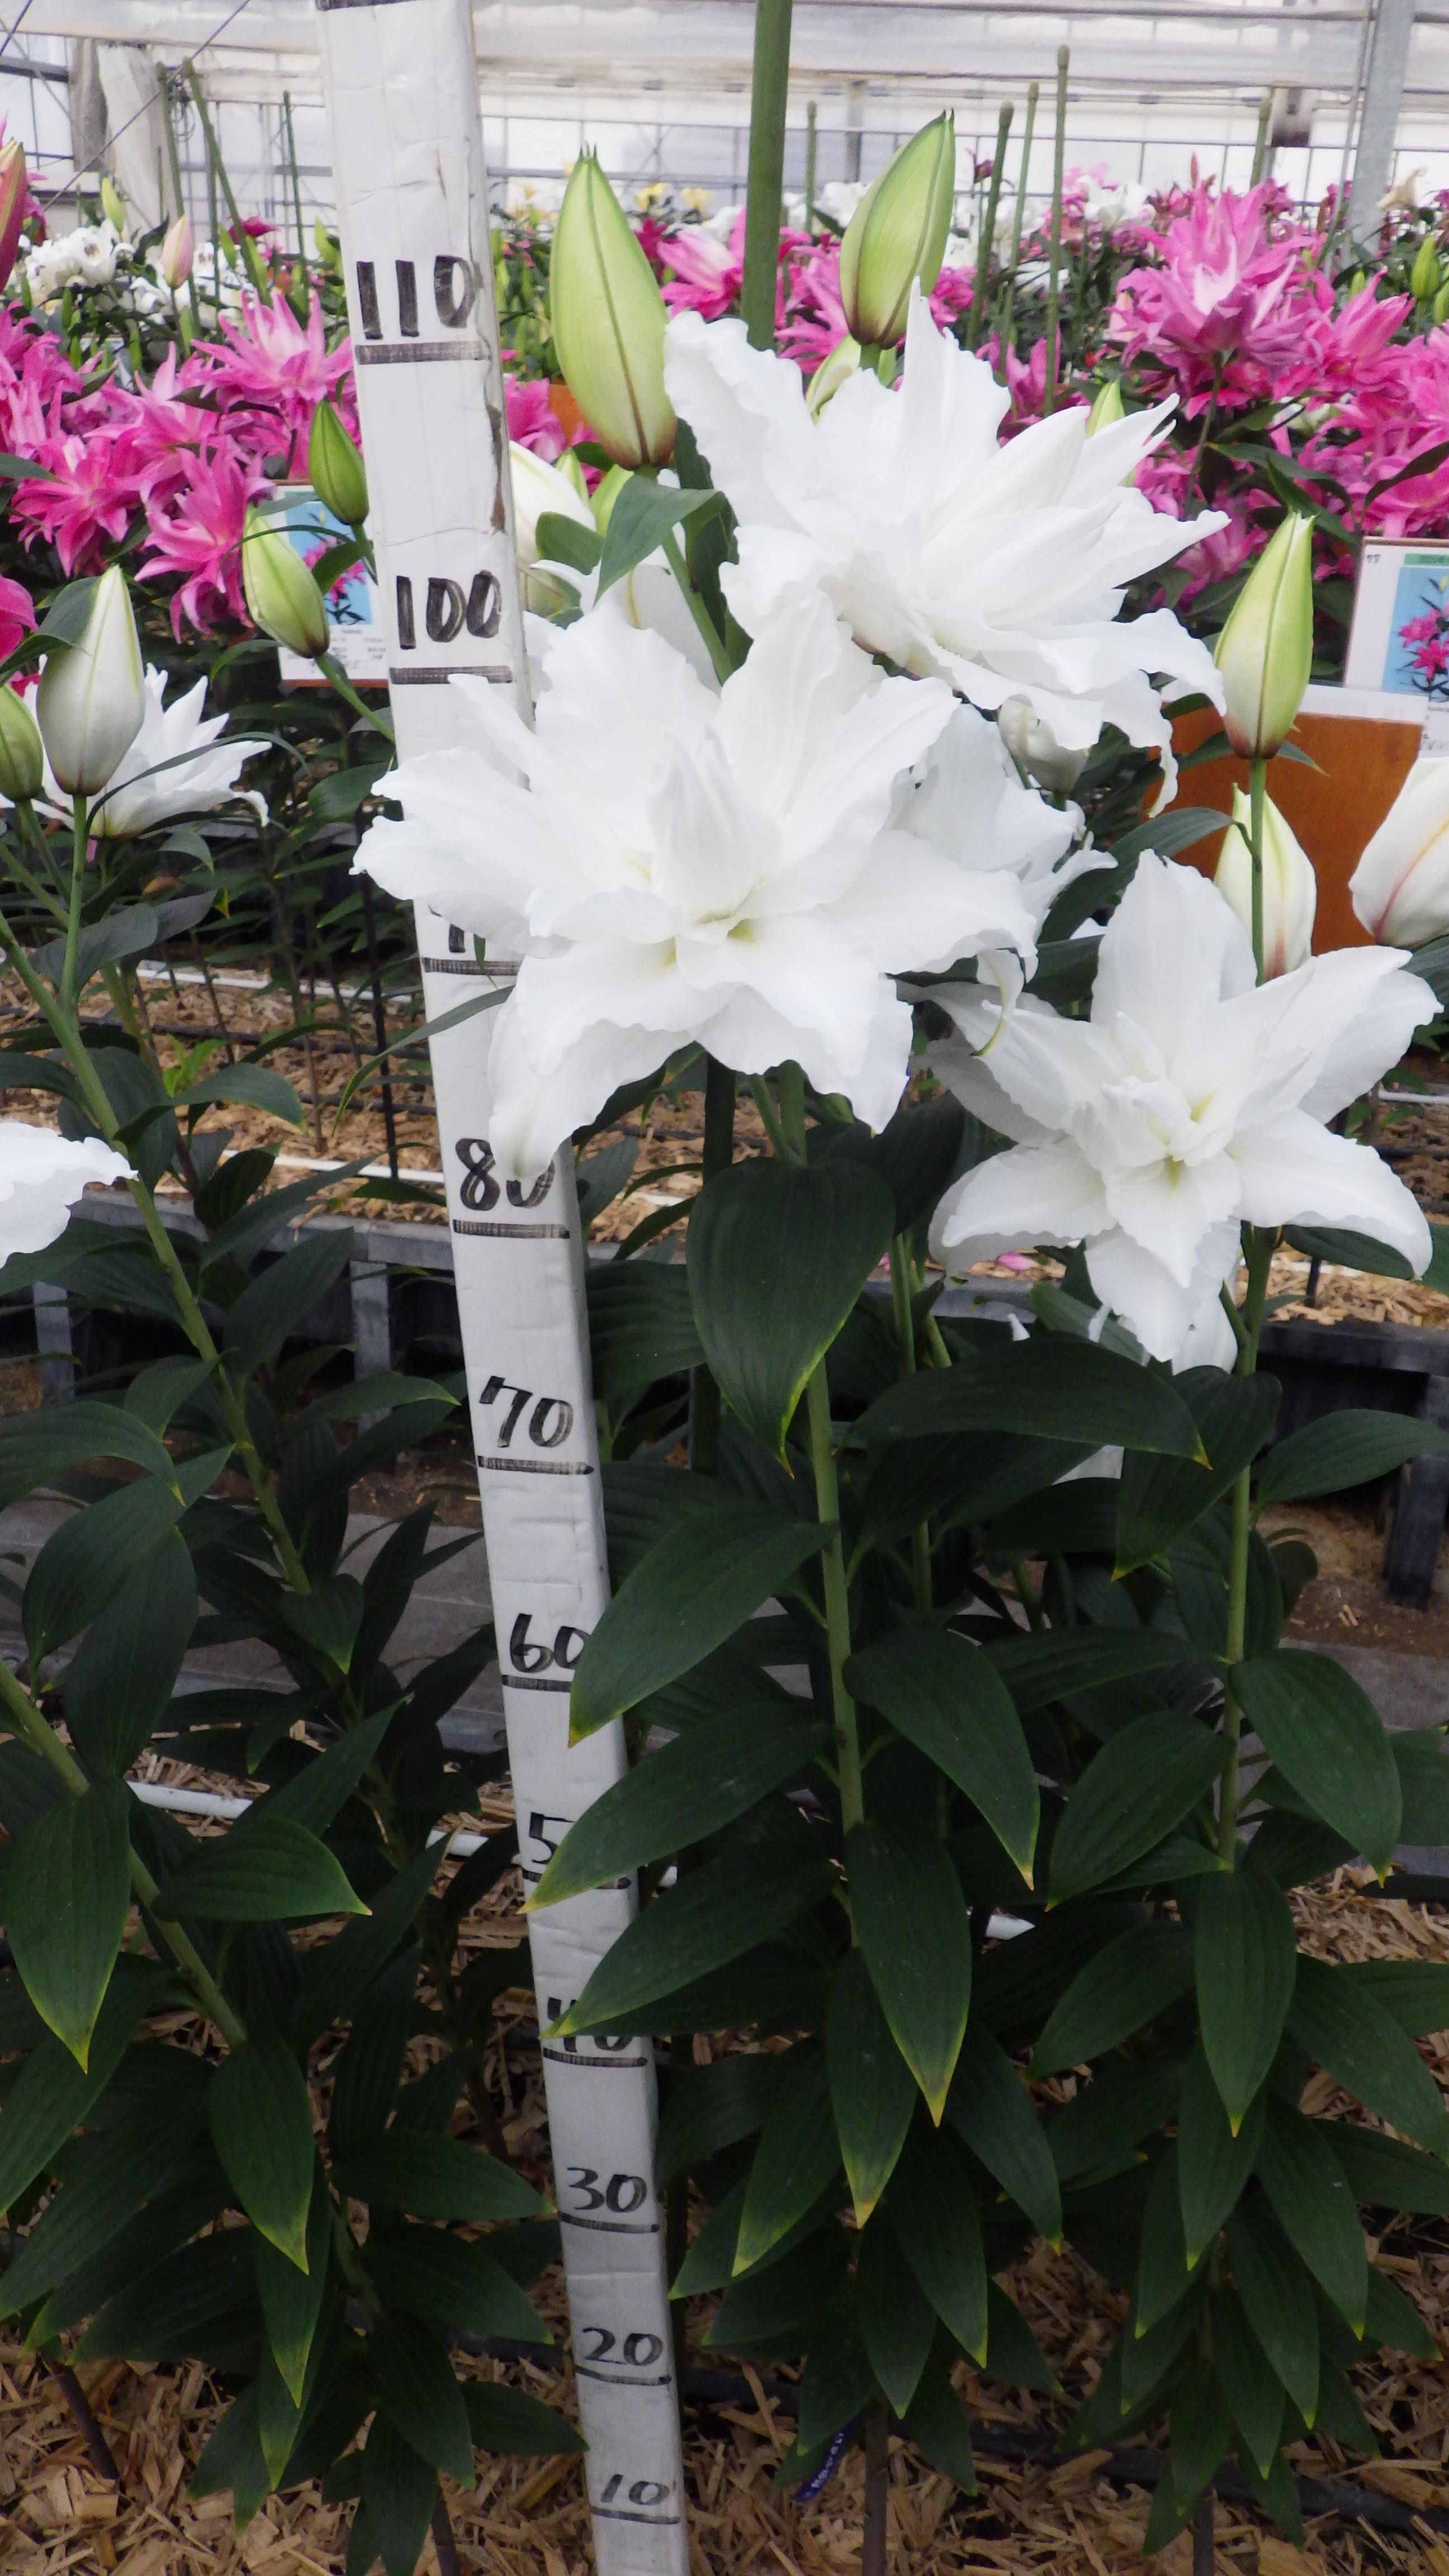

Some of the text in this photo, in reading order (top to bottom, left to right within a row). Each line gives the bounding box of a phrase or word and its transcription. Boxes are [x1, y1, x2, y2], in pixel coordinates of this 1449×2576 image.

[356, 255, 481, 340] 110
[396, 569, 502, 650] 100
[479, 1375, 574, 1448] 70
[509, 1613, 591, 1674] 60
[528, 1811, 575, 1864] 5
[567, 2167, 647, 2213] 30
[582, 2327, 664, 2366] 20
[600, 2474, 670, 2506] 10
